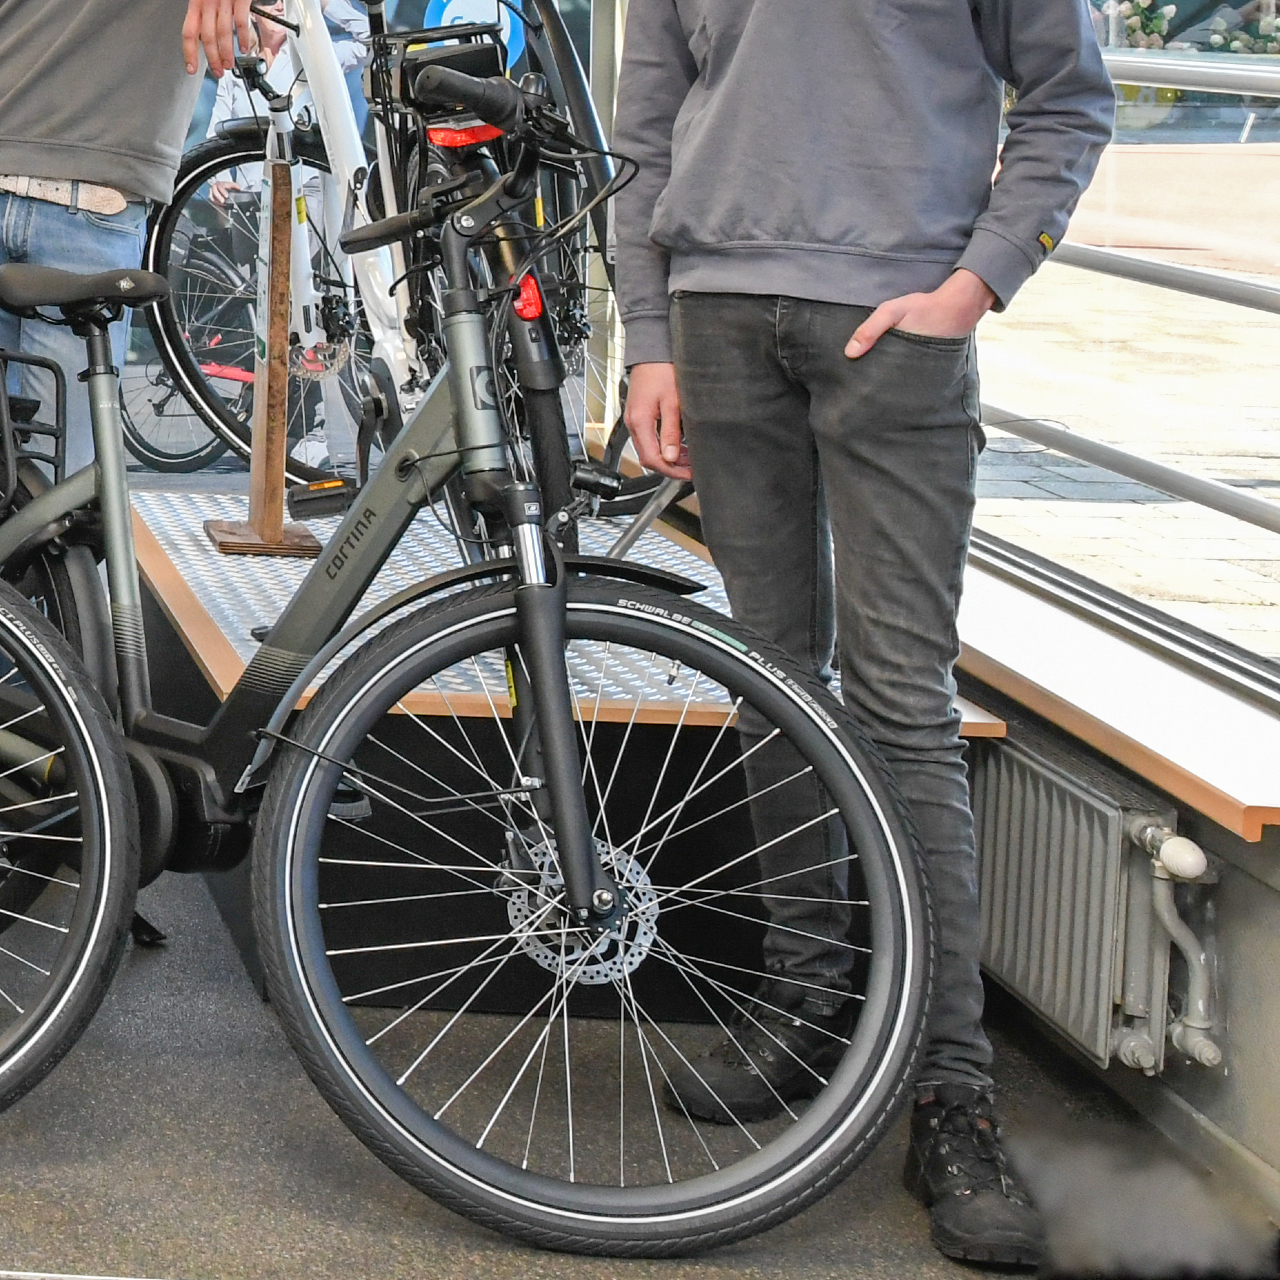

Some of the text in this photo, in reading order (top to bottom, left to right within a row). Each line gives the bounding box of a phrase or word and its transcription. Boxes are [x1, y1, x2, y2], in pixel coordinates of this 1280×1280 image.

[326, 508, 377, 580] CORTINA
[13, 620, 41, 645] PLUS
[617, 598, 787, 679] SCHWALBE PLUS
